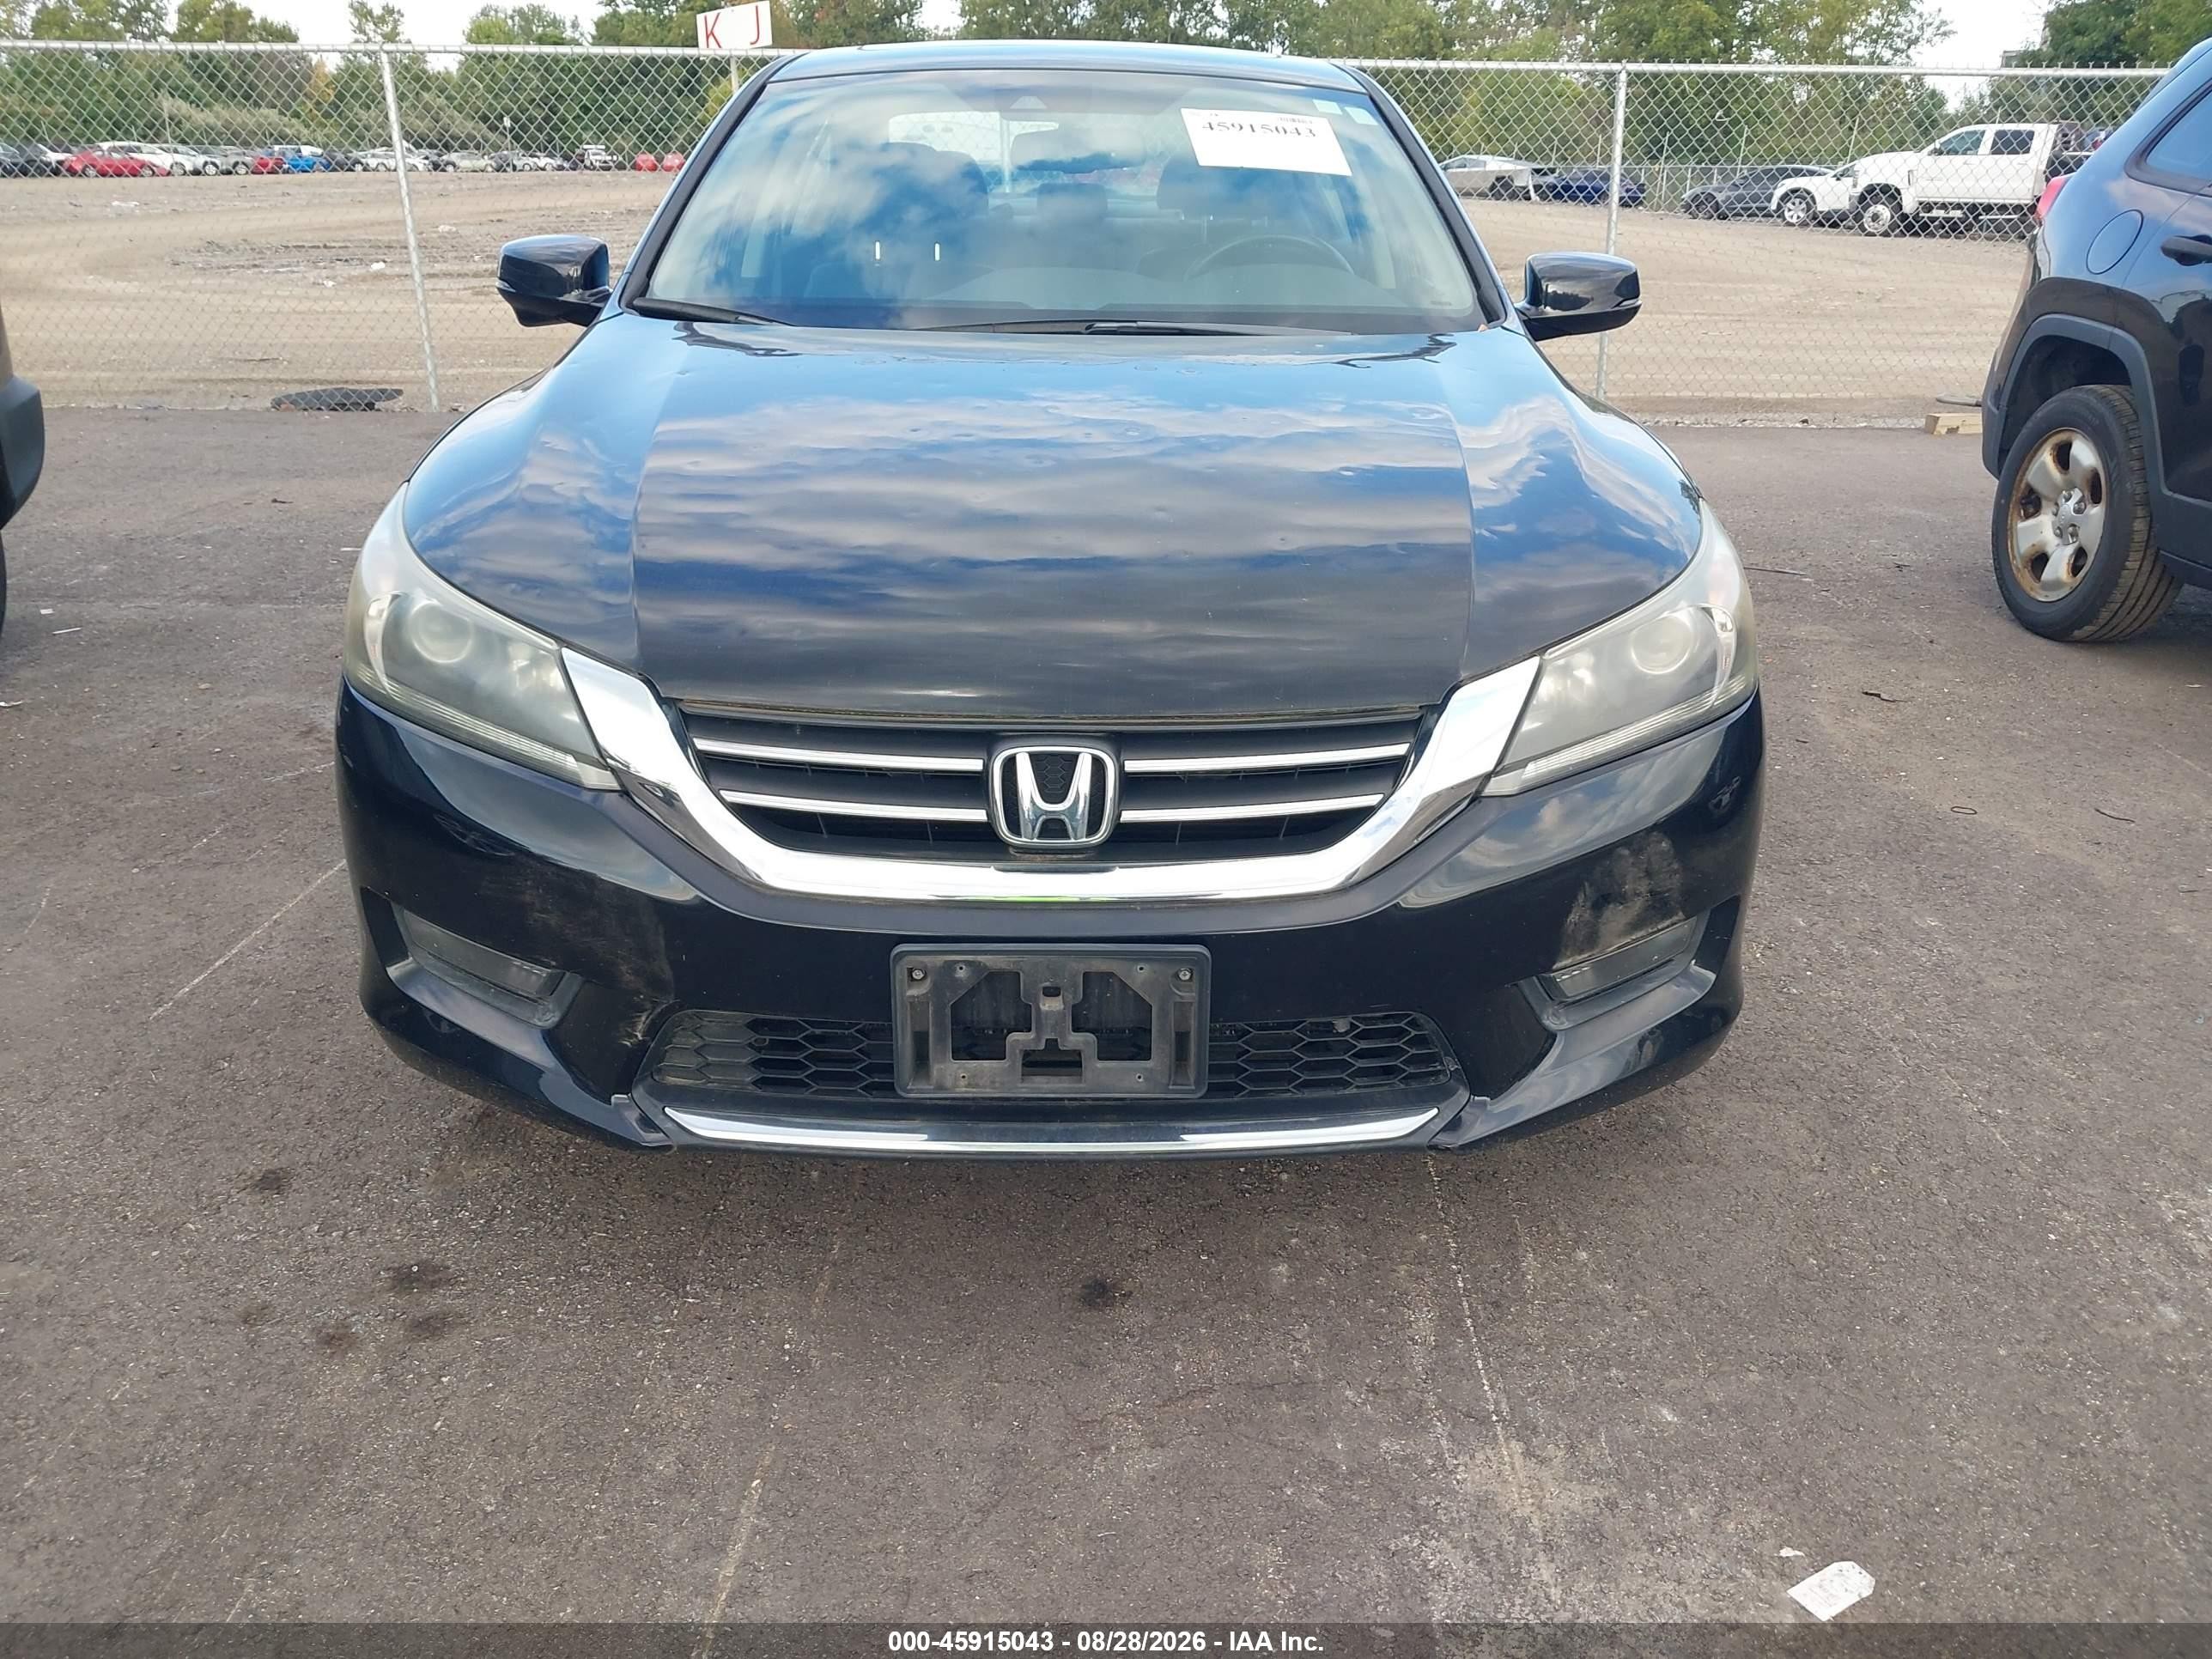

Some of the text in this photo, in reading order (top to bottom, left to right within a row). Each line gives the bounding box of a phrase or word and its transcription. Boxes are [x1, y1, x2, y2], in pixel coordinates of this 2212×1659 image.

[704, 5, 760, 48] K J
[1202, 121, 1316, 137] 45915043
